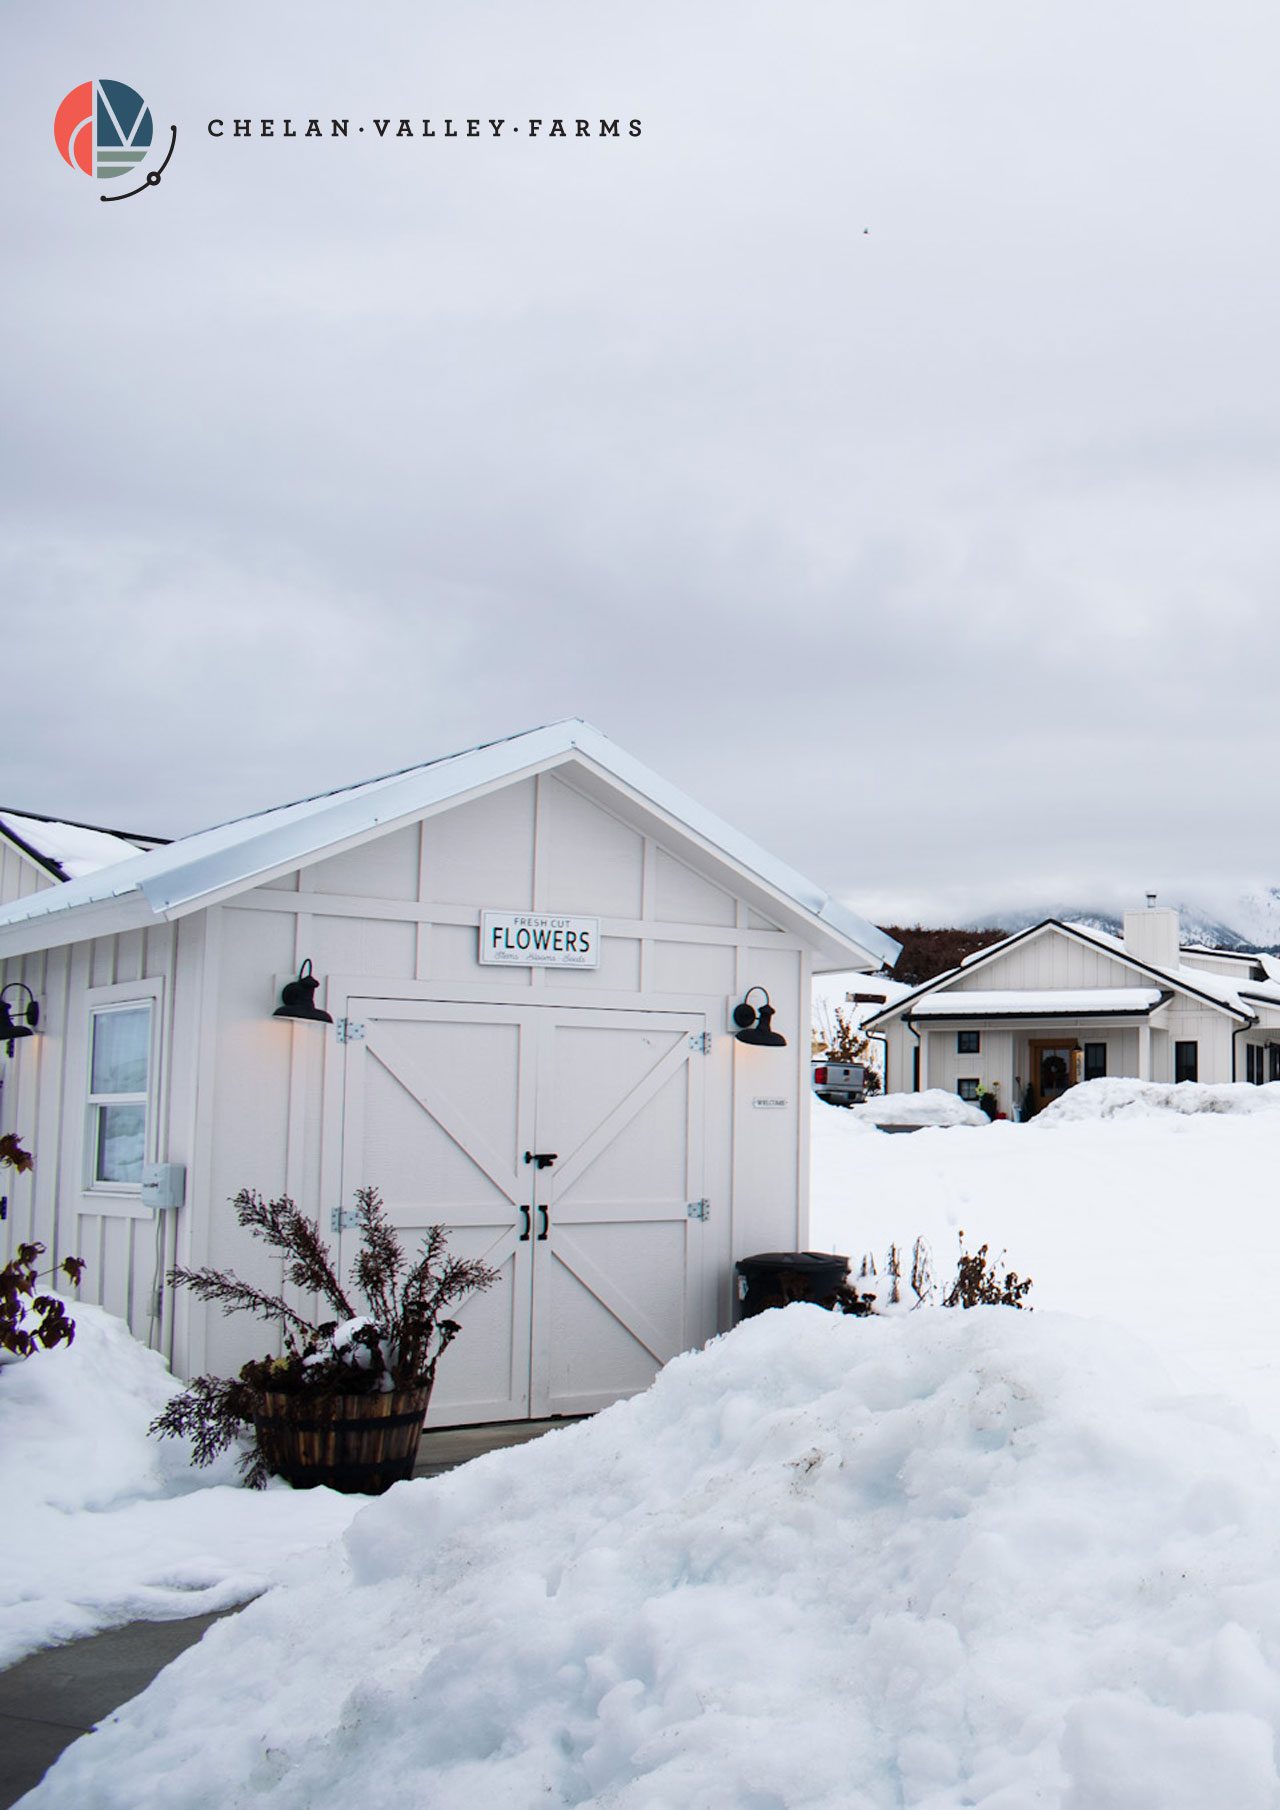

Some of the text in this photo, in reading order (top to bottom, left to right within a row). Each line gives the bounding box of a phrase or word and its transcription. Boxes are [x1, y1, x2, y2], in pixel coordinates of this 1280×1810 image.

[513, 917, 571, 929] FRESH CUT
[492, 927, 590, 953] FLOWERS
